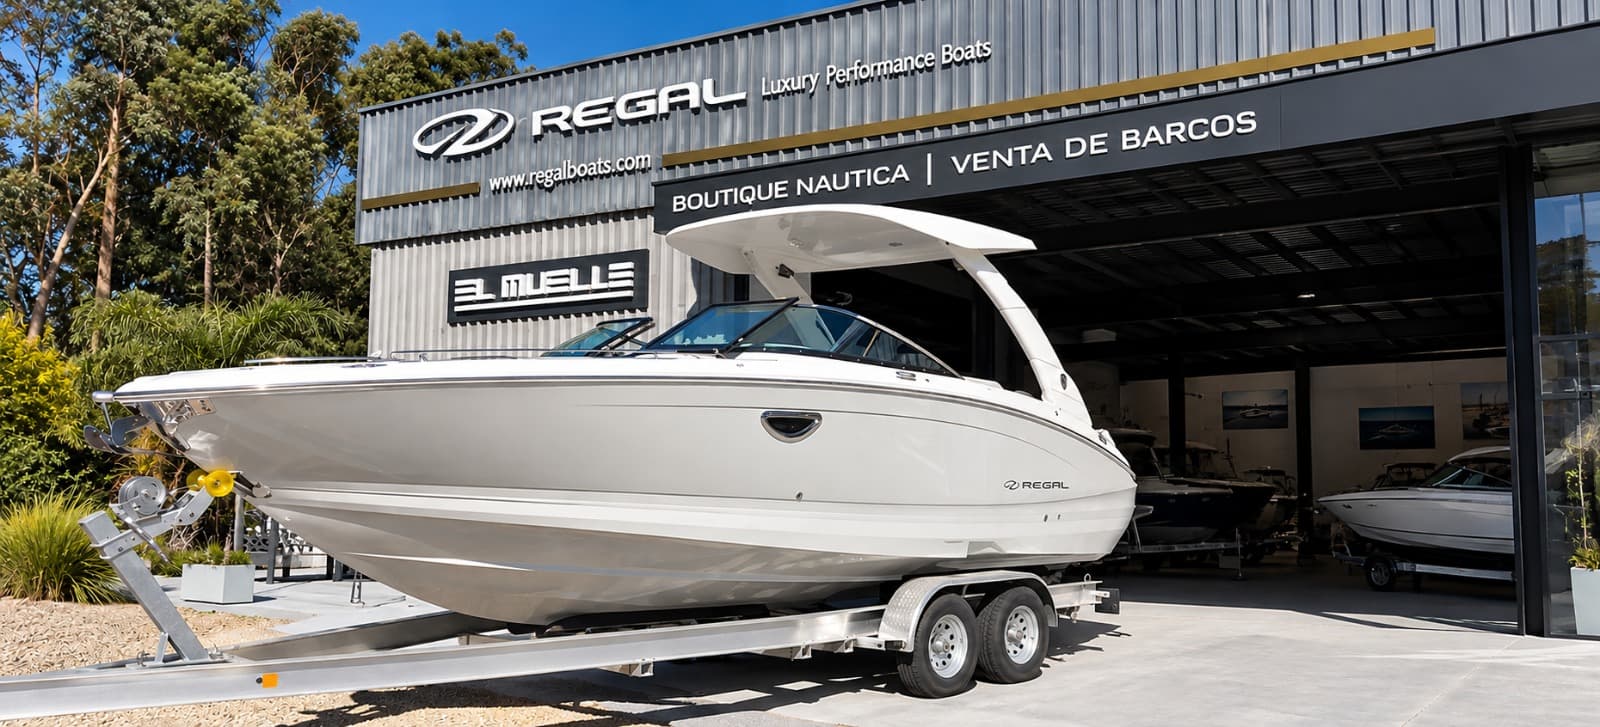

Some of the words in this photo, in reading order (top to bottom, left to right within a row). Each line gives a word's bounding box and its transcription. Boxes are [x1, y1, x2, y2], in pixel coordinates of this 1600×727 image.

[761, 71, 820, 96] Luxury
[825, 51, 936, 86] Performance
[940, 39, 992, 65] Boats
[531, 78, 748, 137] REGAL
[489, 153, 651, 188] www.regalboats.com
[672, 180, 789, 213] BOUTIQUE
[796, 164, 910, 196] NAUTICA
[950, 142, 1053, 175] VENTA
[1064, 132, 1109, 159] DE
[1121, 110, 1257, 151] BARCOS
[454, 278, 496, 303] EL
[501, 261, 635, 299] MUELLE
[1021, 481, 1070, 489] REGAL
